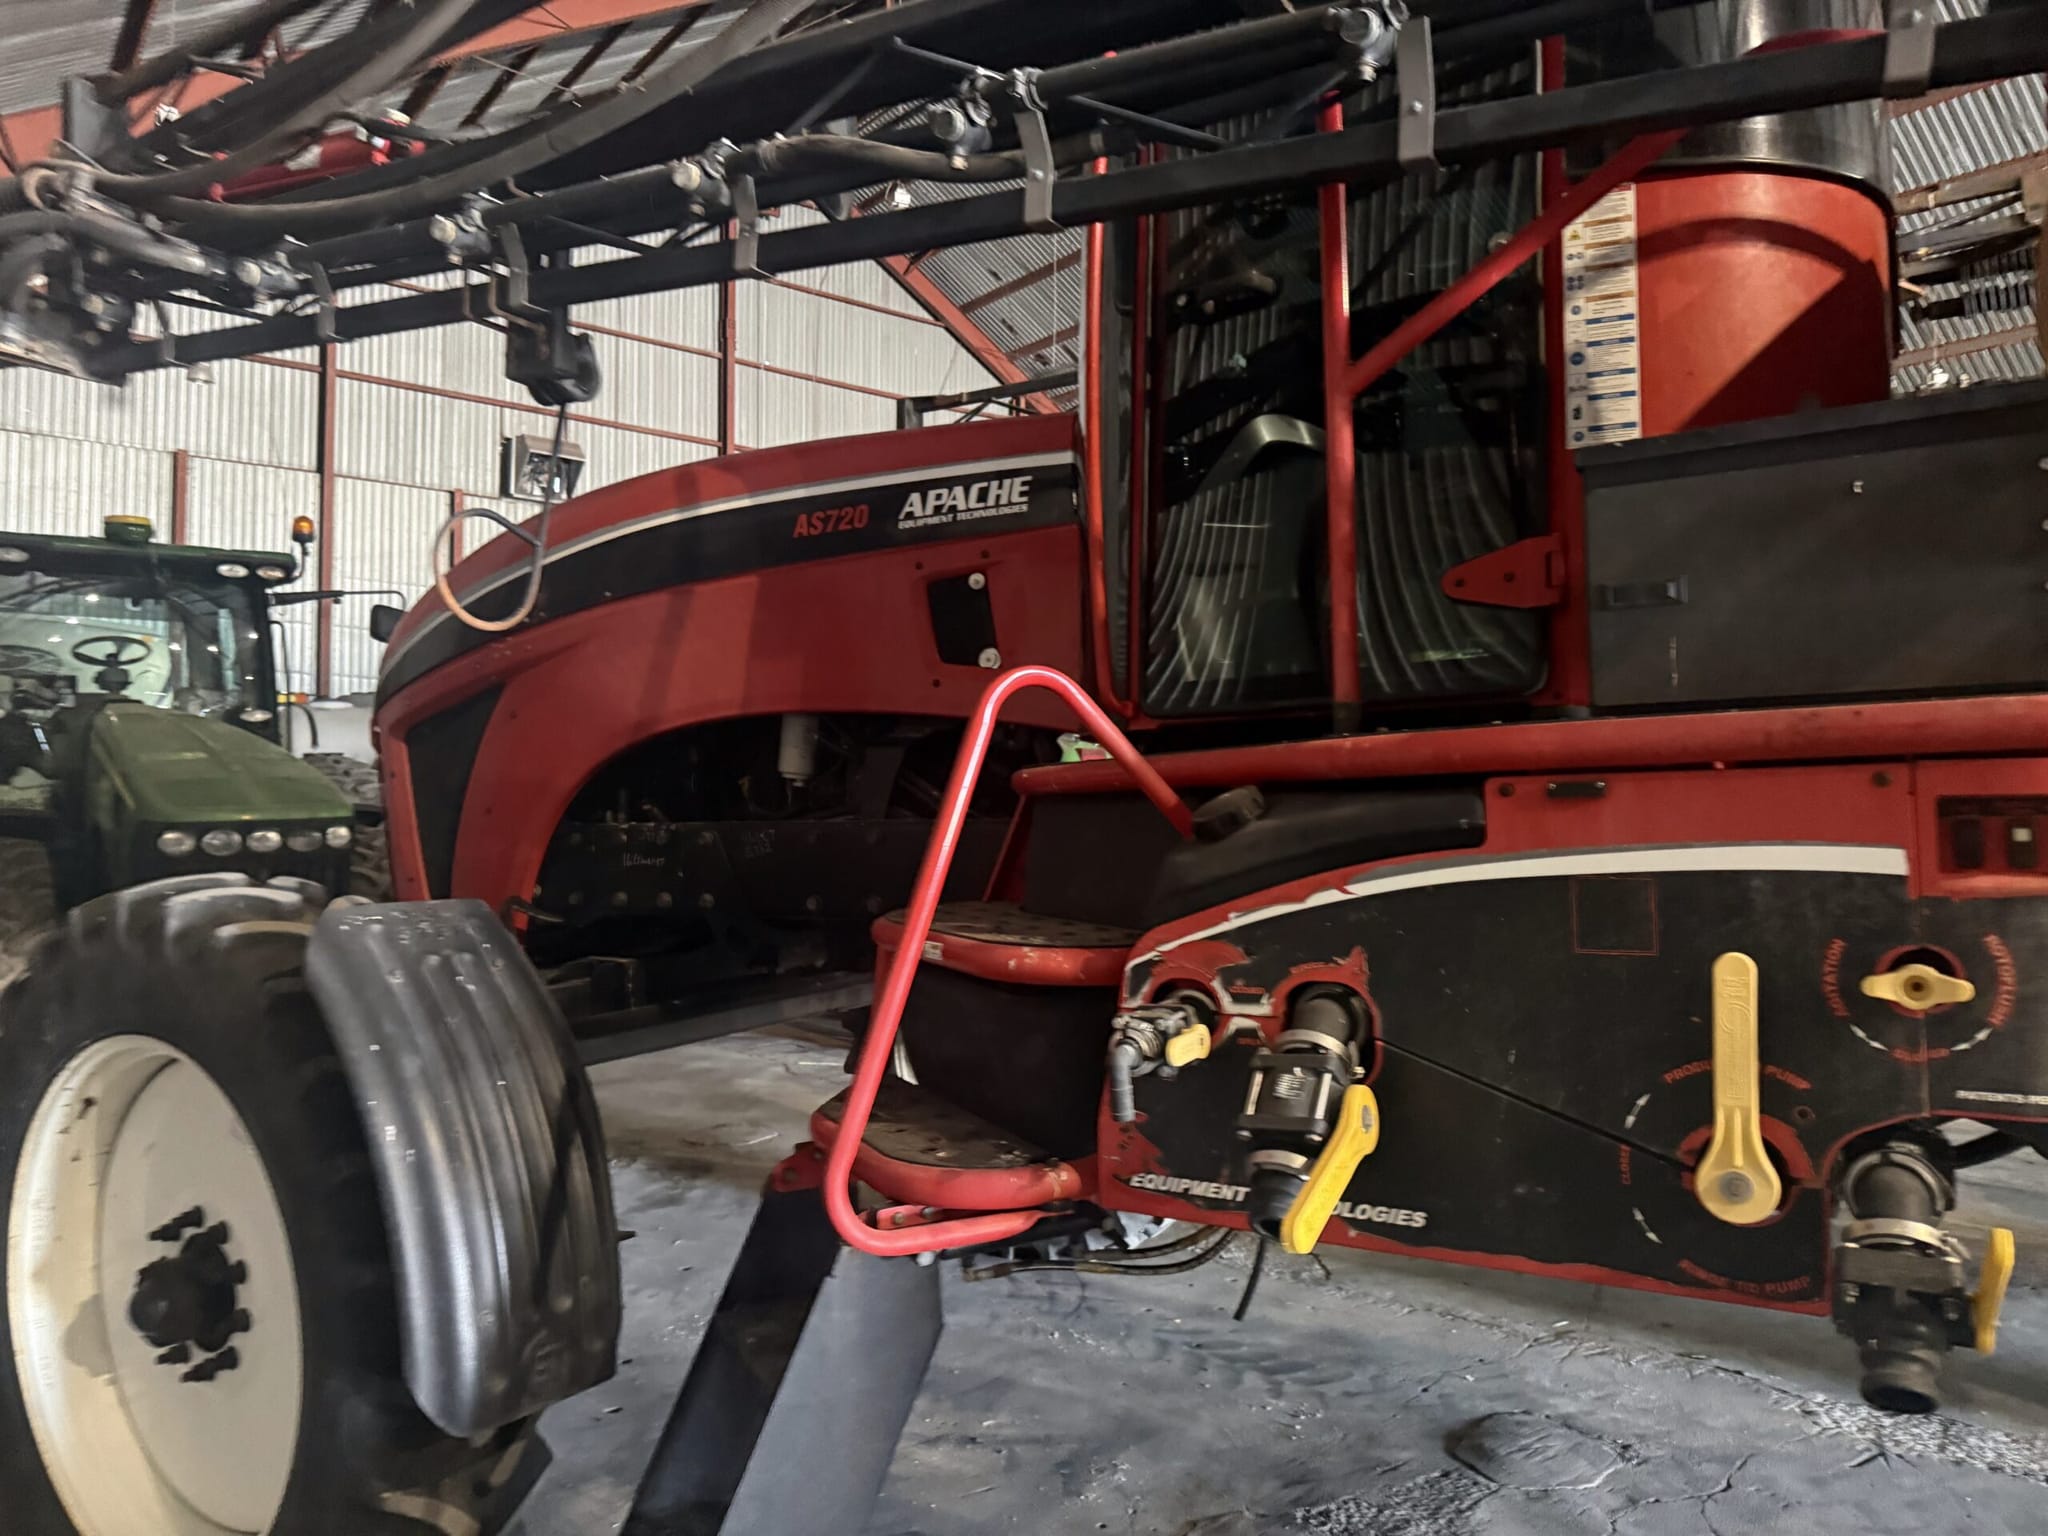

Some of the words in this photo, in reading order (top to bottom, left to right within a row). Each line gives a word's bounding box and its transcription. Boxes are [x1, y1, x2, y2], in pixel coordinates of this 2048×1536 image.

[898, 476, 1032, 520] APACHE
[898, 513, 954, 529] EQUIPMENT
[956, 504, 1028, 522] TECHNOLOGIES
[792, 505, 870, 538] AS720
[1821, 938, 1849, 1016] AGITATION
[1129, 1173, 1251, 1202] EQUIPMENT
[1330, 1201, 1429, 1228] OLOGIES
[1763, 1275, 1811, 1295] PUMP
